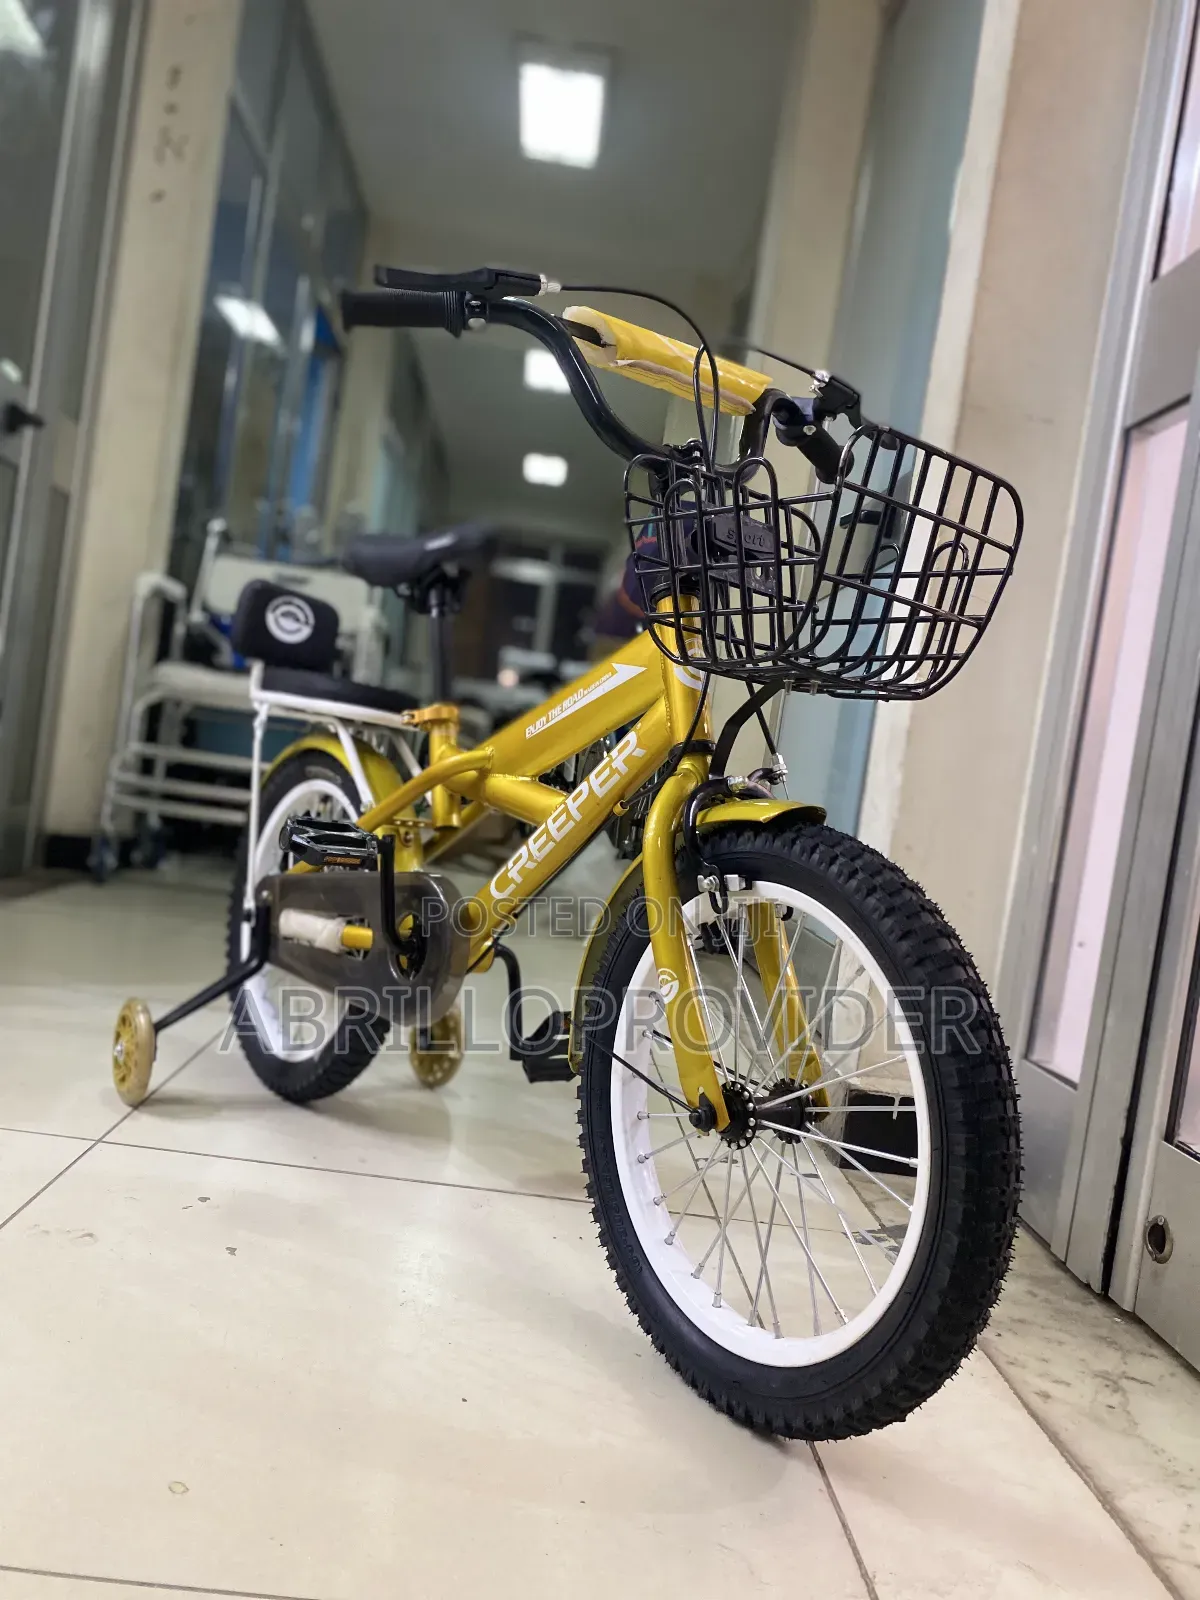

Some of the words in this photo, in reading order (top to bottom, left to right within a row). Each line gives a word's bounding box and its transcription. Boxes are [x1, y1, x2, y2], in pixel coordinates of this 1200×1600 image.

[525, 716, 547, 737] ENJOY
[548, 704, 562, 721] THE
[562, 688, 584, 711] ROAD
[489, 730, 647, 899] CREEPER
